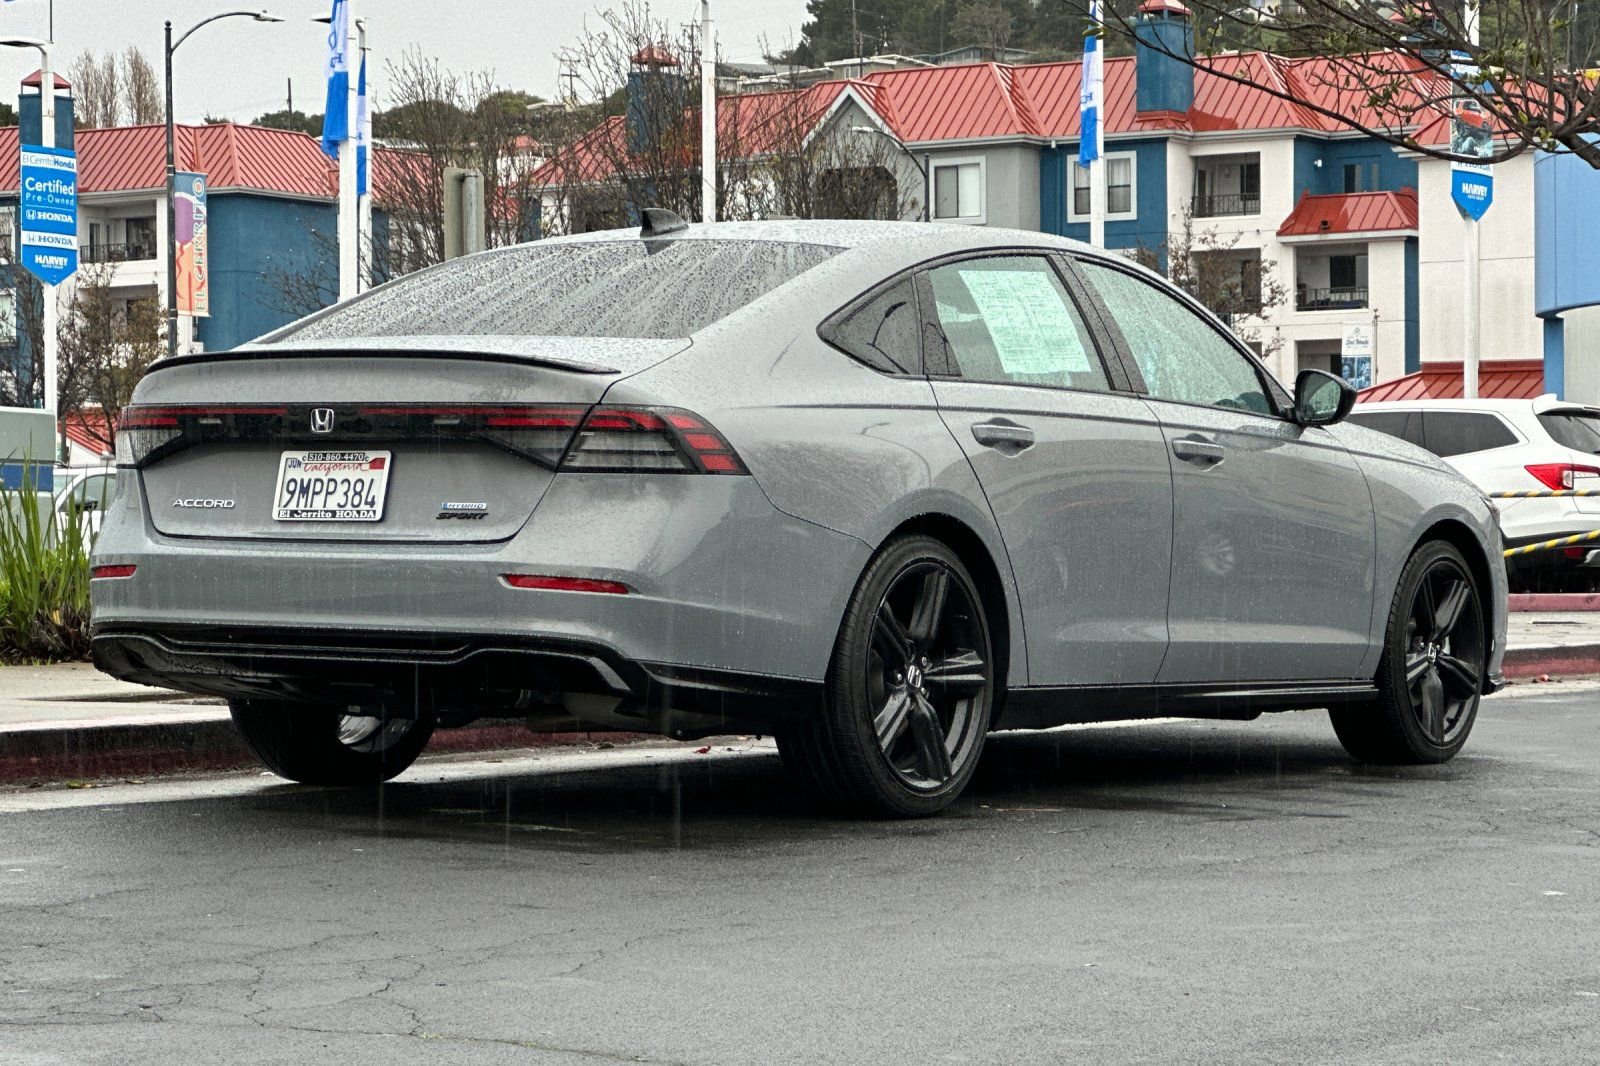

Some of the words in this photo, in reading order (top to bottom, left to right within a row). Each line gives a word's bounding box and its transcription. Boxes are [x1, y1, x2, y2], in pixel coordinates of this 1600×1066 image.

[25, 177, 74, 195] Certified
[25, 193, 74, 206] Pre-Owned
[37, 211, 74, 223] HONDA
[38, 235, 73, 246] HONDA
[35, 254, 68, 266] HARVEY
[308, 453, 364, 461] 510-860-4470
[288, 460, 302, 468] JUN
[283, 477, 376, 508] 9MPP384
[172, 498, 235, 508] ACCORD
[279, 510, 290, 518] El
[335, 510, 375, 518] HONDA
